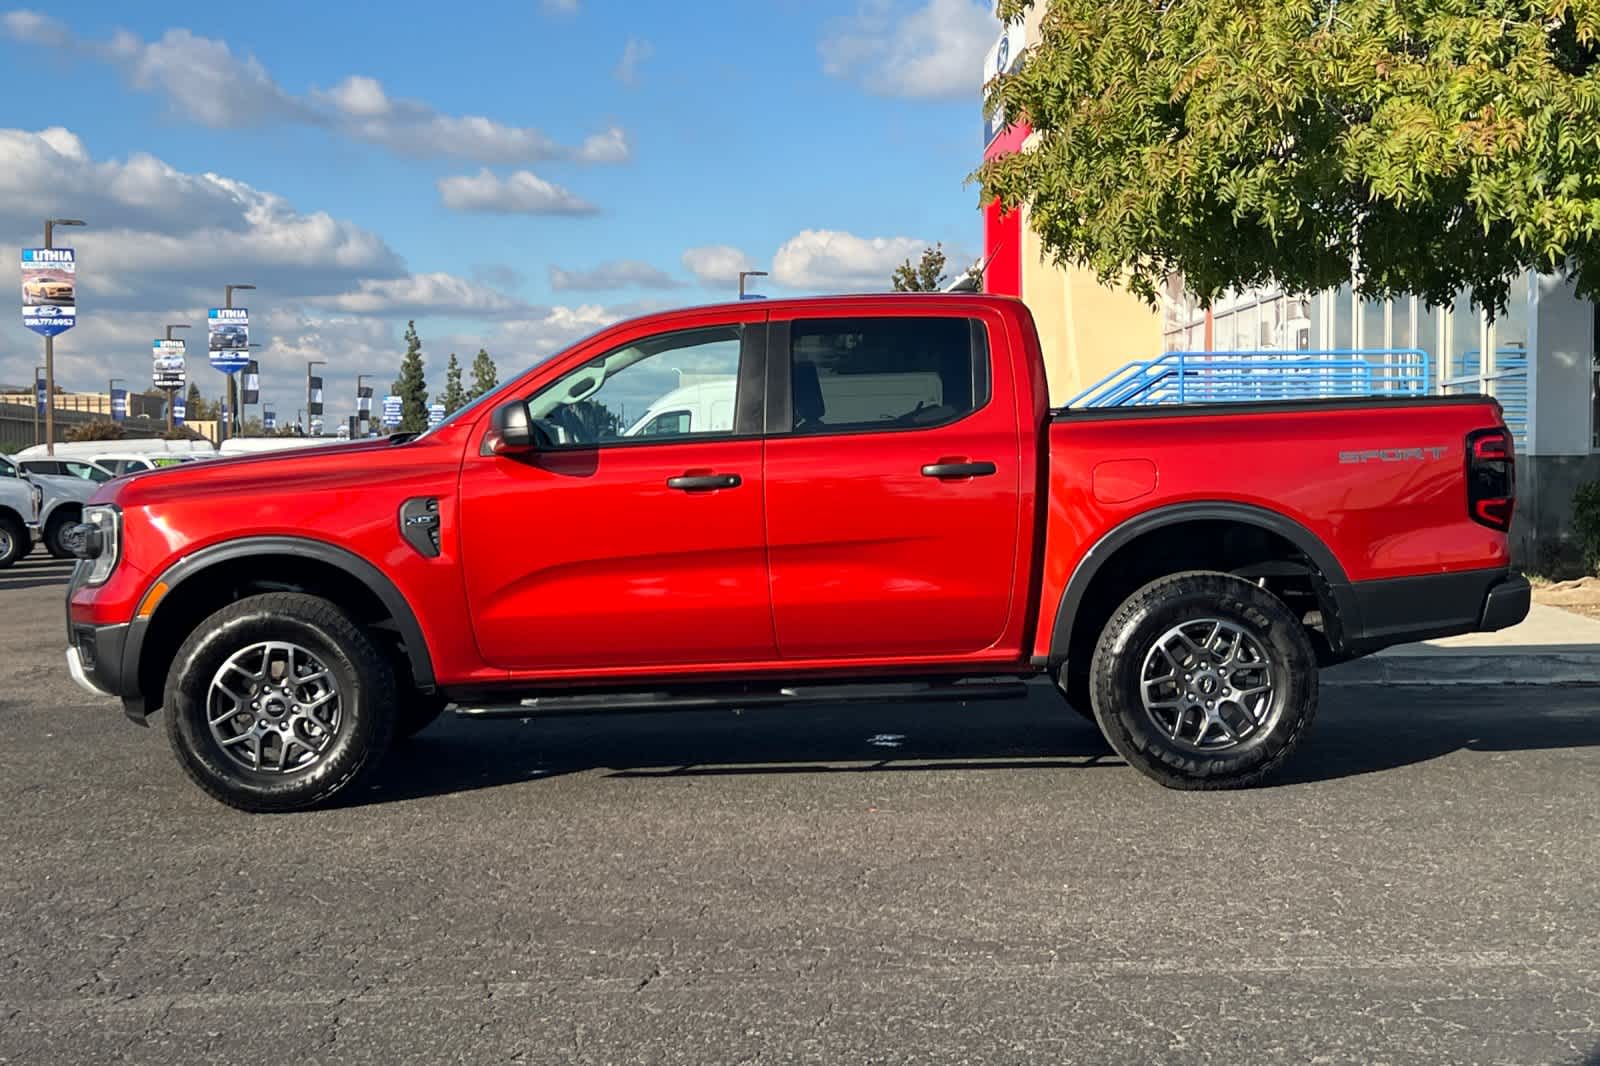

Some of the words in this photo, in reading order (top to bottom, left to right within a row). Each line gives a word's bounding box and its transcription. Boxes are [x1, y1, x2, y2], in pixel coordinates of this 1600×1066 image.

[32, 250, 73, 262] LITHIA
[217, 309, 247, 318] LITHIA
[1338, 446, 1448, 464] SPORT
